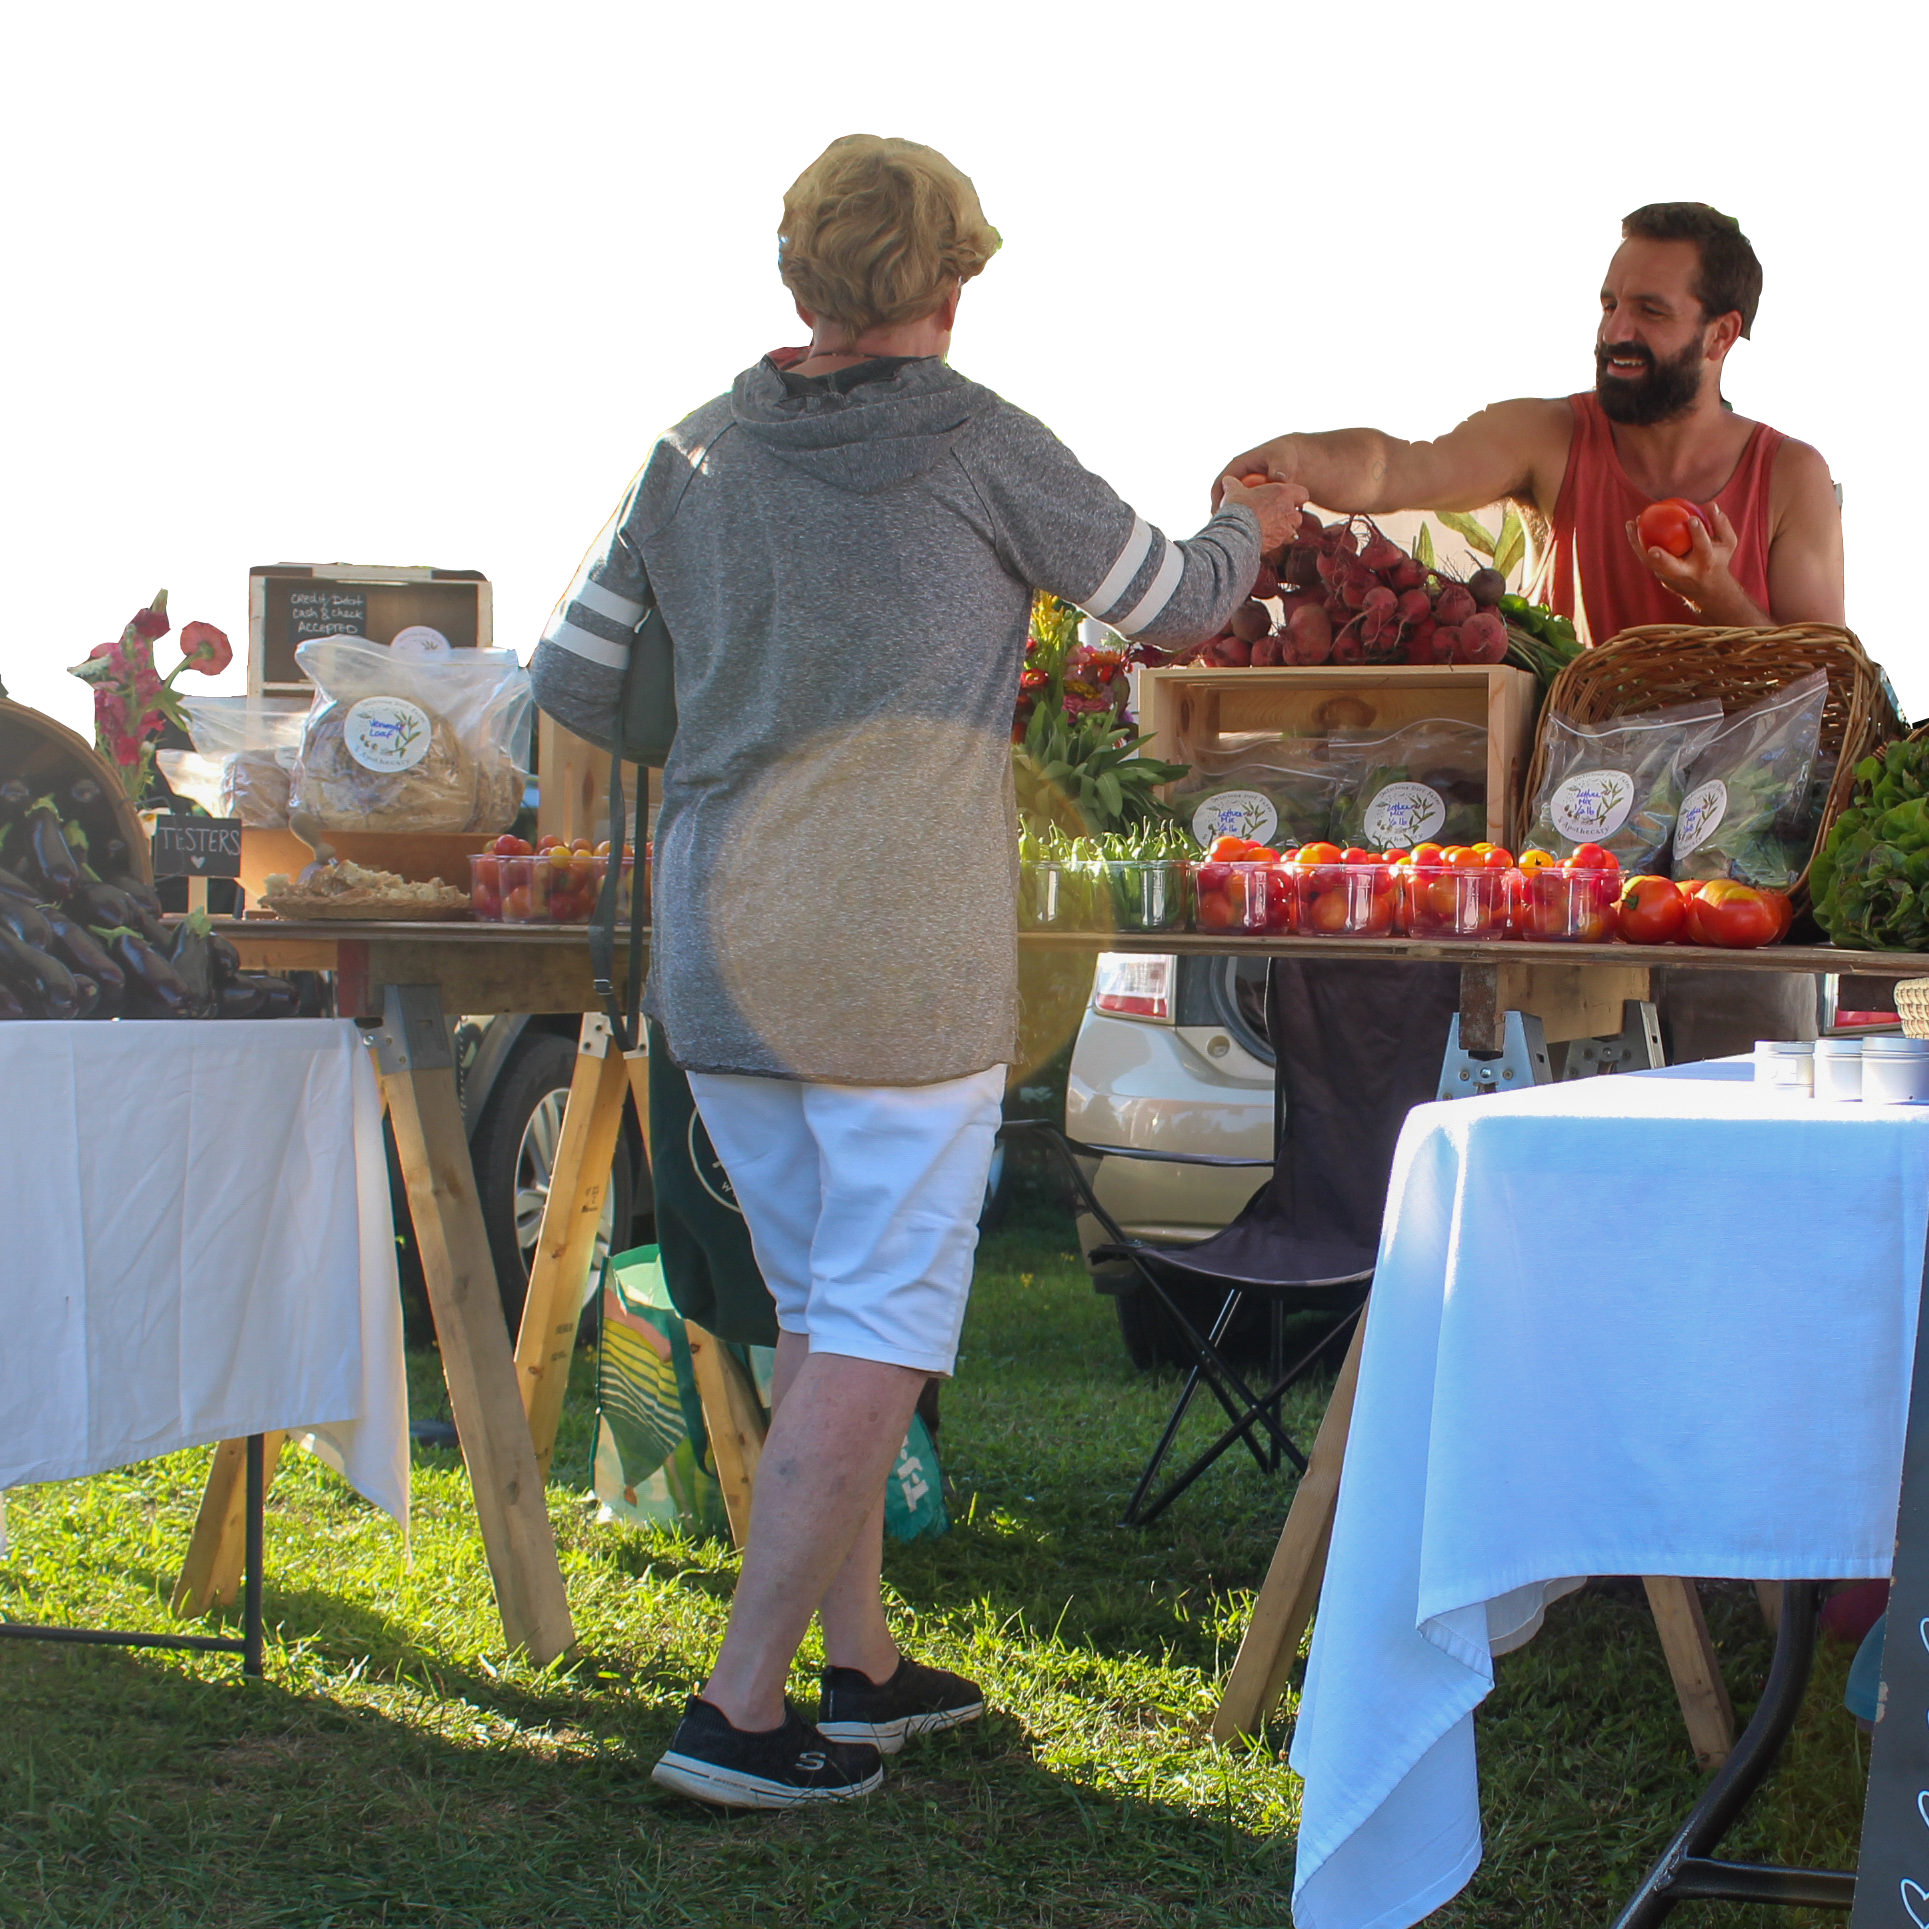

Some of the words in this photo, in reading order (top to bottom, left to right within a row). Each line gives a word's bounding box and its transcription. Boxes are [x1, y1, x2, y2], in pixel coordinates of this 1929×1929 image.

[1092, 241, 1319, 372] Delicious
[1343, 225, 1456, 278] Dirt
[1477, 248, 1600, 366] Farm
[158, 826, 241, 856] TESTERS
[795, 1751, 827, 1771] S
